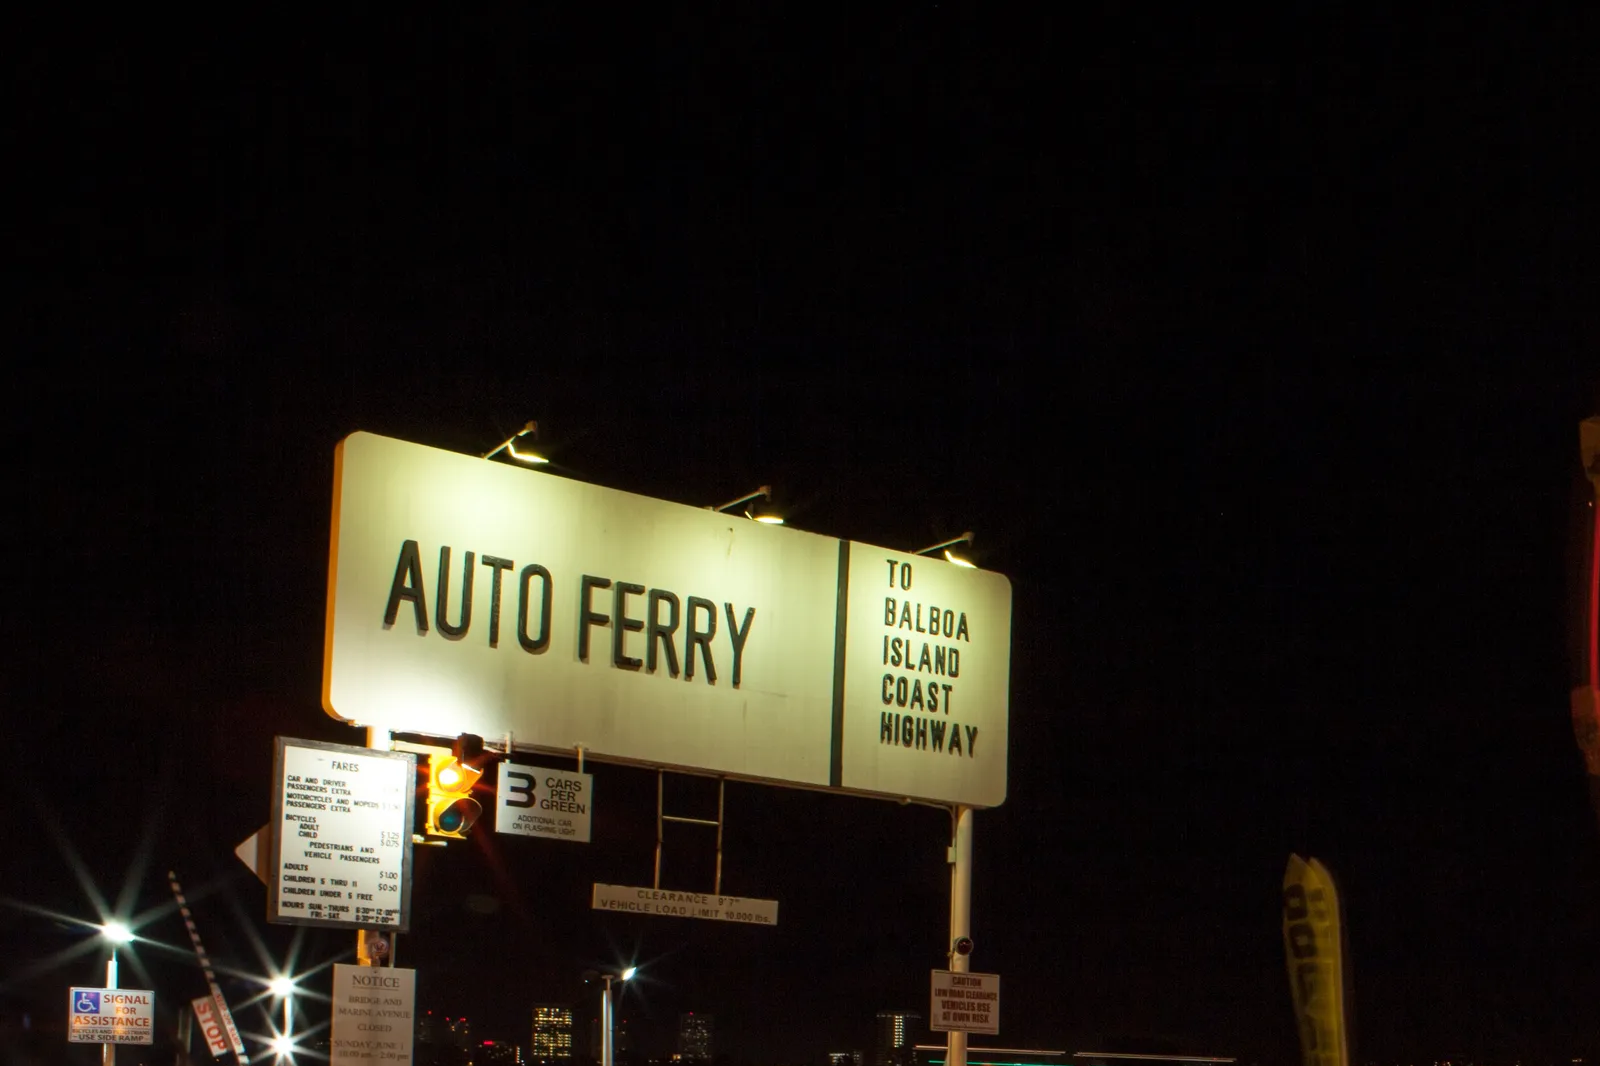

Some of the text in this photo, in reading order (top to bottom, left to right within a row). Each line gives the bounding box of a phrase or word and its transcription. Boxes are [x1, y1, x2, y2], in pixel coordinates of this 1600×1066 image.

[886, 559, 912, 590] TO
[383, 539, 756, 689] AUTO FERRY
[884, 596, 970, 642] BALBOA
[883, 635, 960, 678] ISLAND
[882, 673, 953, 715] COAST
[880, 712, 978, 758] HIGHWAY
[332, 760, 360, 772] FARES
[286, 782, 351, 796] PASSENGERS EXTRA
[322, 779, 346, 788] DRIVER
[506, 770, 536, 808] 3
[545, 777, 582, 792] CARS
[286, 792, 332, 804] MOTORCYCLES
[354, 800, 379, 810] MOPEDS
[550, 789, 576, 802] PER
[286, 800, 351, 813] PASSENGERS EXTRA
[540, 799, 586, 814] GREEN
[285, 814, 316, 823] BICYCLES
[517, 814, 556, 825] ADDITIONAL
[299, 823, 320, 831] ADULT
[524, 824, 556, 834] FLASHING
[298, 830, 318, 838] CHILD
[309, 841, 354, 852] PEDESTRIANS
[304, 851, 380, 864] VEHICLE PASSENGERS
[284, 862, 308, 871] ADULTS
[283, 874, 316, 884] CHILDREN
[330, 878, 348, 887] THRU
[282, 886, 316, 896] CHILDREN
[320, 890, 342, 898] UNDER
[356, 893, 373, 901] FREE
[637, 890, 708, 905] CLEARANCE
[282, 900, 304, 910] HOURS
[601, 900, 650, 912] VEHICLE
[656, 904, 686, 916] LOAD
[691, 906, 720, 918] LIMIT
[352, 974, 400, 988] NOTICE
[952, 976, 982, 986] CAUTION
[104, 994, 150, 1005] SIGNAL
[348, 995, 402, 1006] BRIDGE AND
[116, 1006, 136, 1015] FOR
[942, 1000, 991, 1012] VEHICLES USE
[338, 1008, 412, 1019] MARINE AVENUE
[942, 1012, 990, 1024] AT OWN RISK
[73, 1016, 150, 1026] ASSISTANCE
[196, 1001, 228, 1050] STOP
[356, 1024, 392, 1032] CLOSED
[376, 1042, 398, 1050] JUNE
